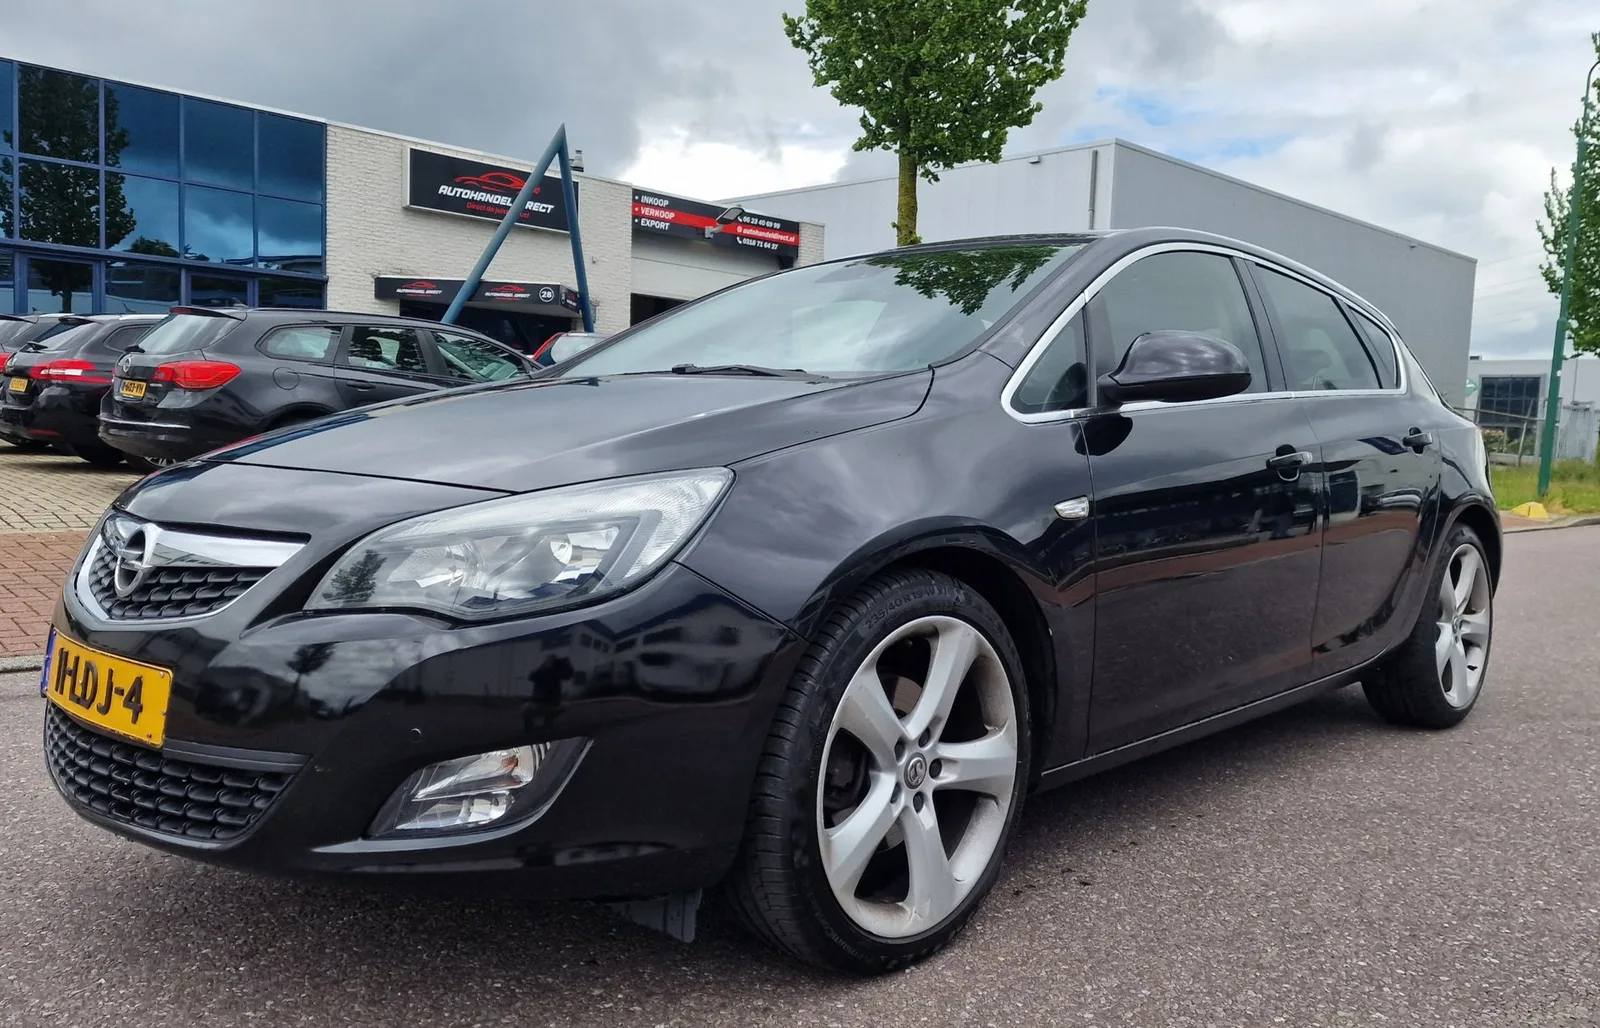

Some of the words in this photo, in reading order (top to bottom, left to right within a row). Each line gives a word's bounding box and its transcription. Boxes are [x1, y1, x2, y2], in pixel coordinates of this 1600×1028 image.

[438, 185, 513, 206] AUTOHANDEL
[525, 200, 555, 214] RECT
[641, 195, 669, 208] INKOOP
[466, 202, 485, 211] Direct
[641, 207, 675, 220] VERKOOP
[641, 218, 670, 231] EXPORT
[742, 228, 795, 243] autohandeldirect.nl
[541, 290, 552, 299] 28
